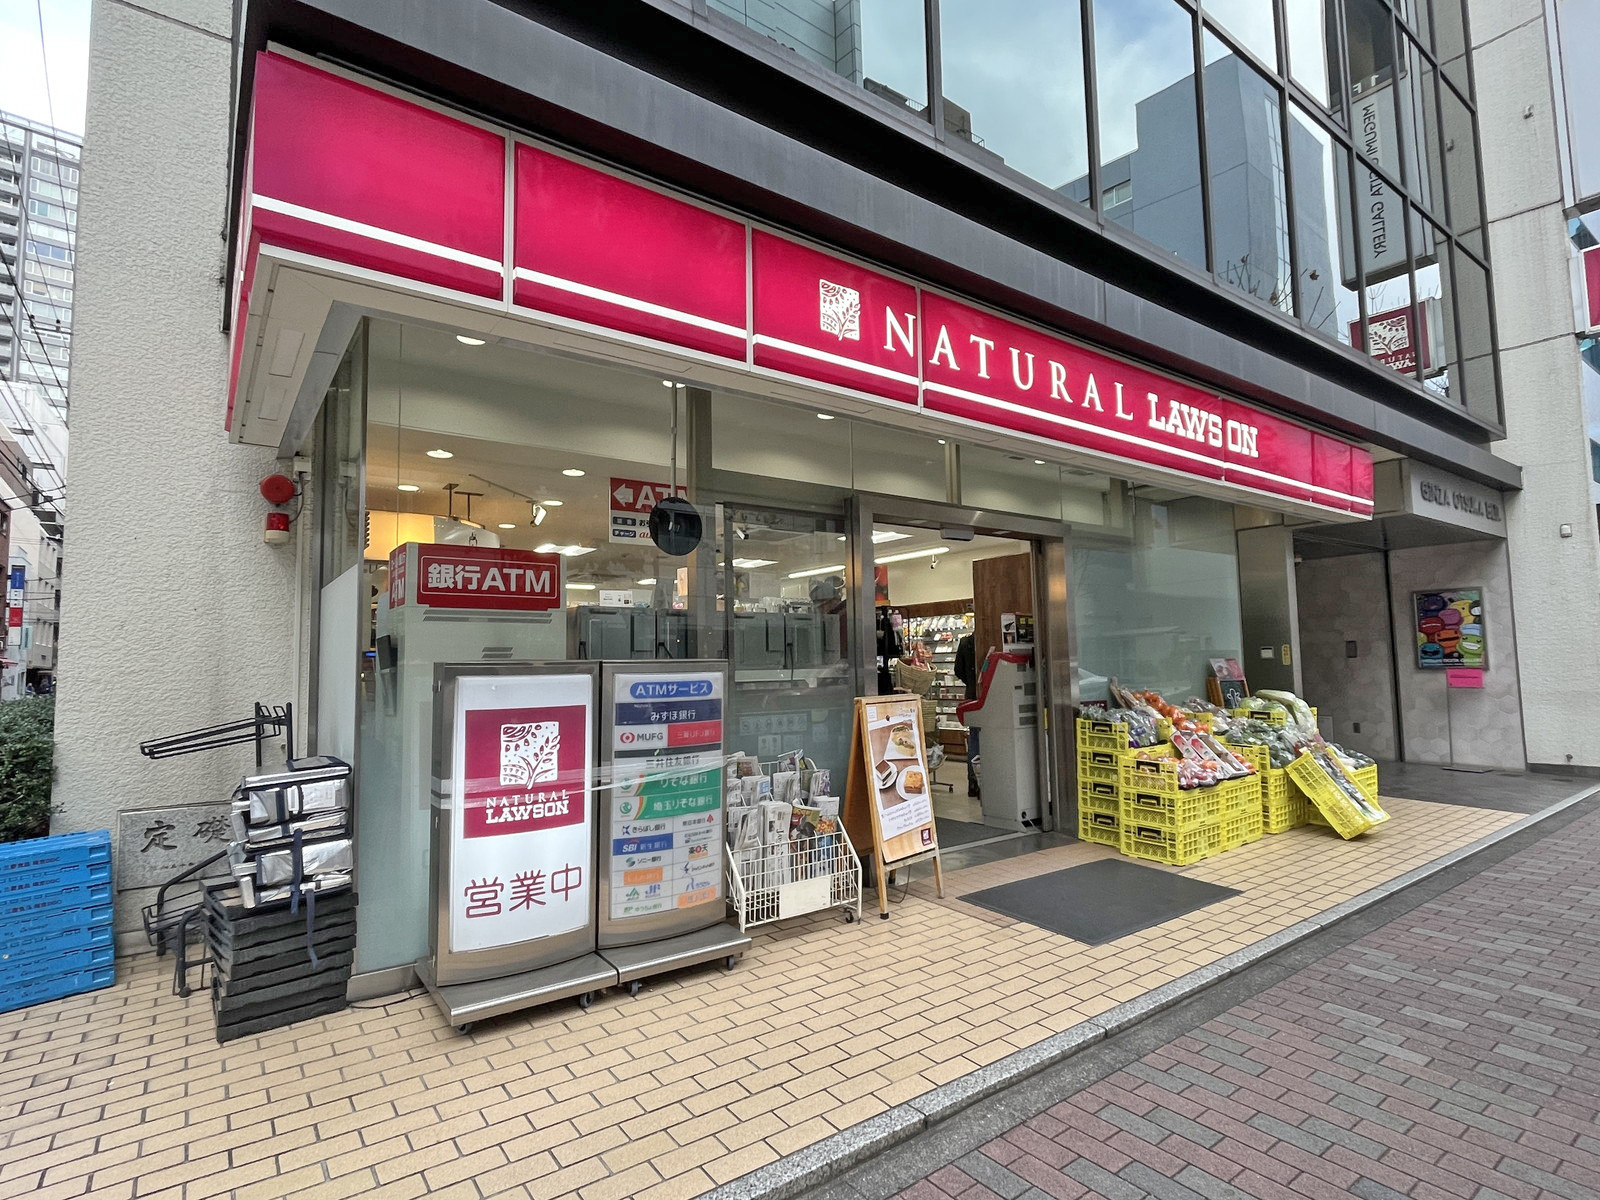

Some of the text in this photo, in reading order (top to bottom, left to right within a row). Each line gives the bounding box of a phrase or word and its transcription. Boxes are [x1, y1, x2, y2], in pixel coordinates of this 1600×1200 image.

[883, 305, 1259, 458] NATURAL LAWSON
[427, 562, 550, 594] 銀行ATM
[635, 682, 708, 696] ATMサービス
[650, 709, 696, 721] みずほ銀行
[636, 732, 664, 742] MUFG
[485, 788, 569, 808] NATURAL
[485, 800, 569, 824] LAWSON
[463, 863, 582, 919] 営業中
